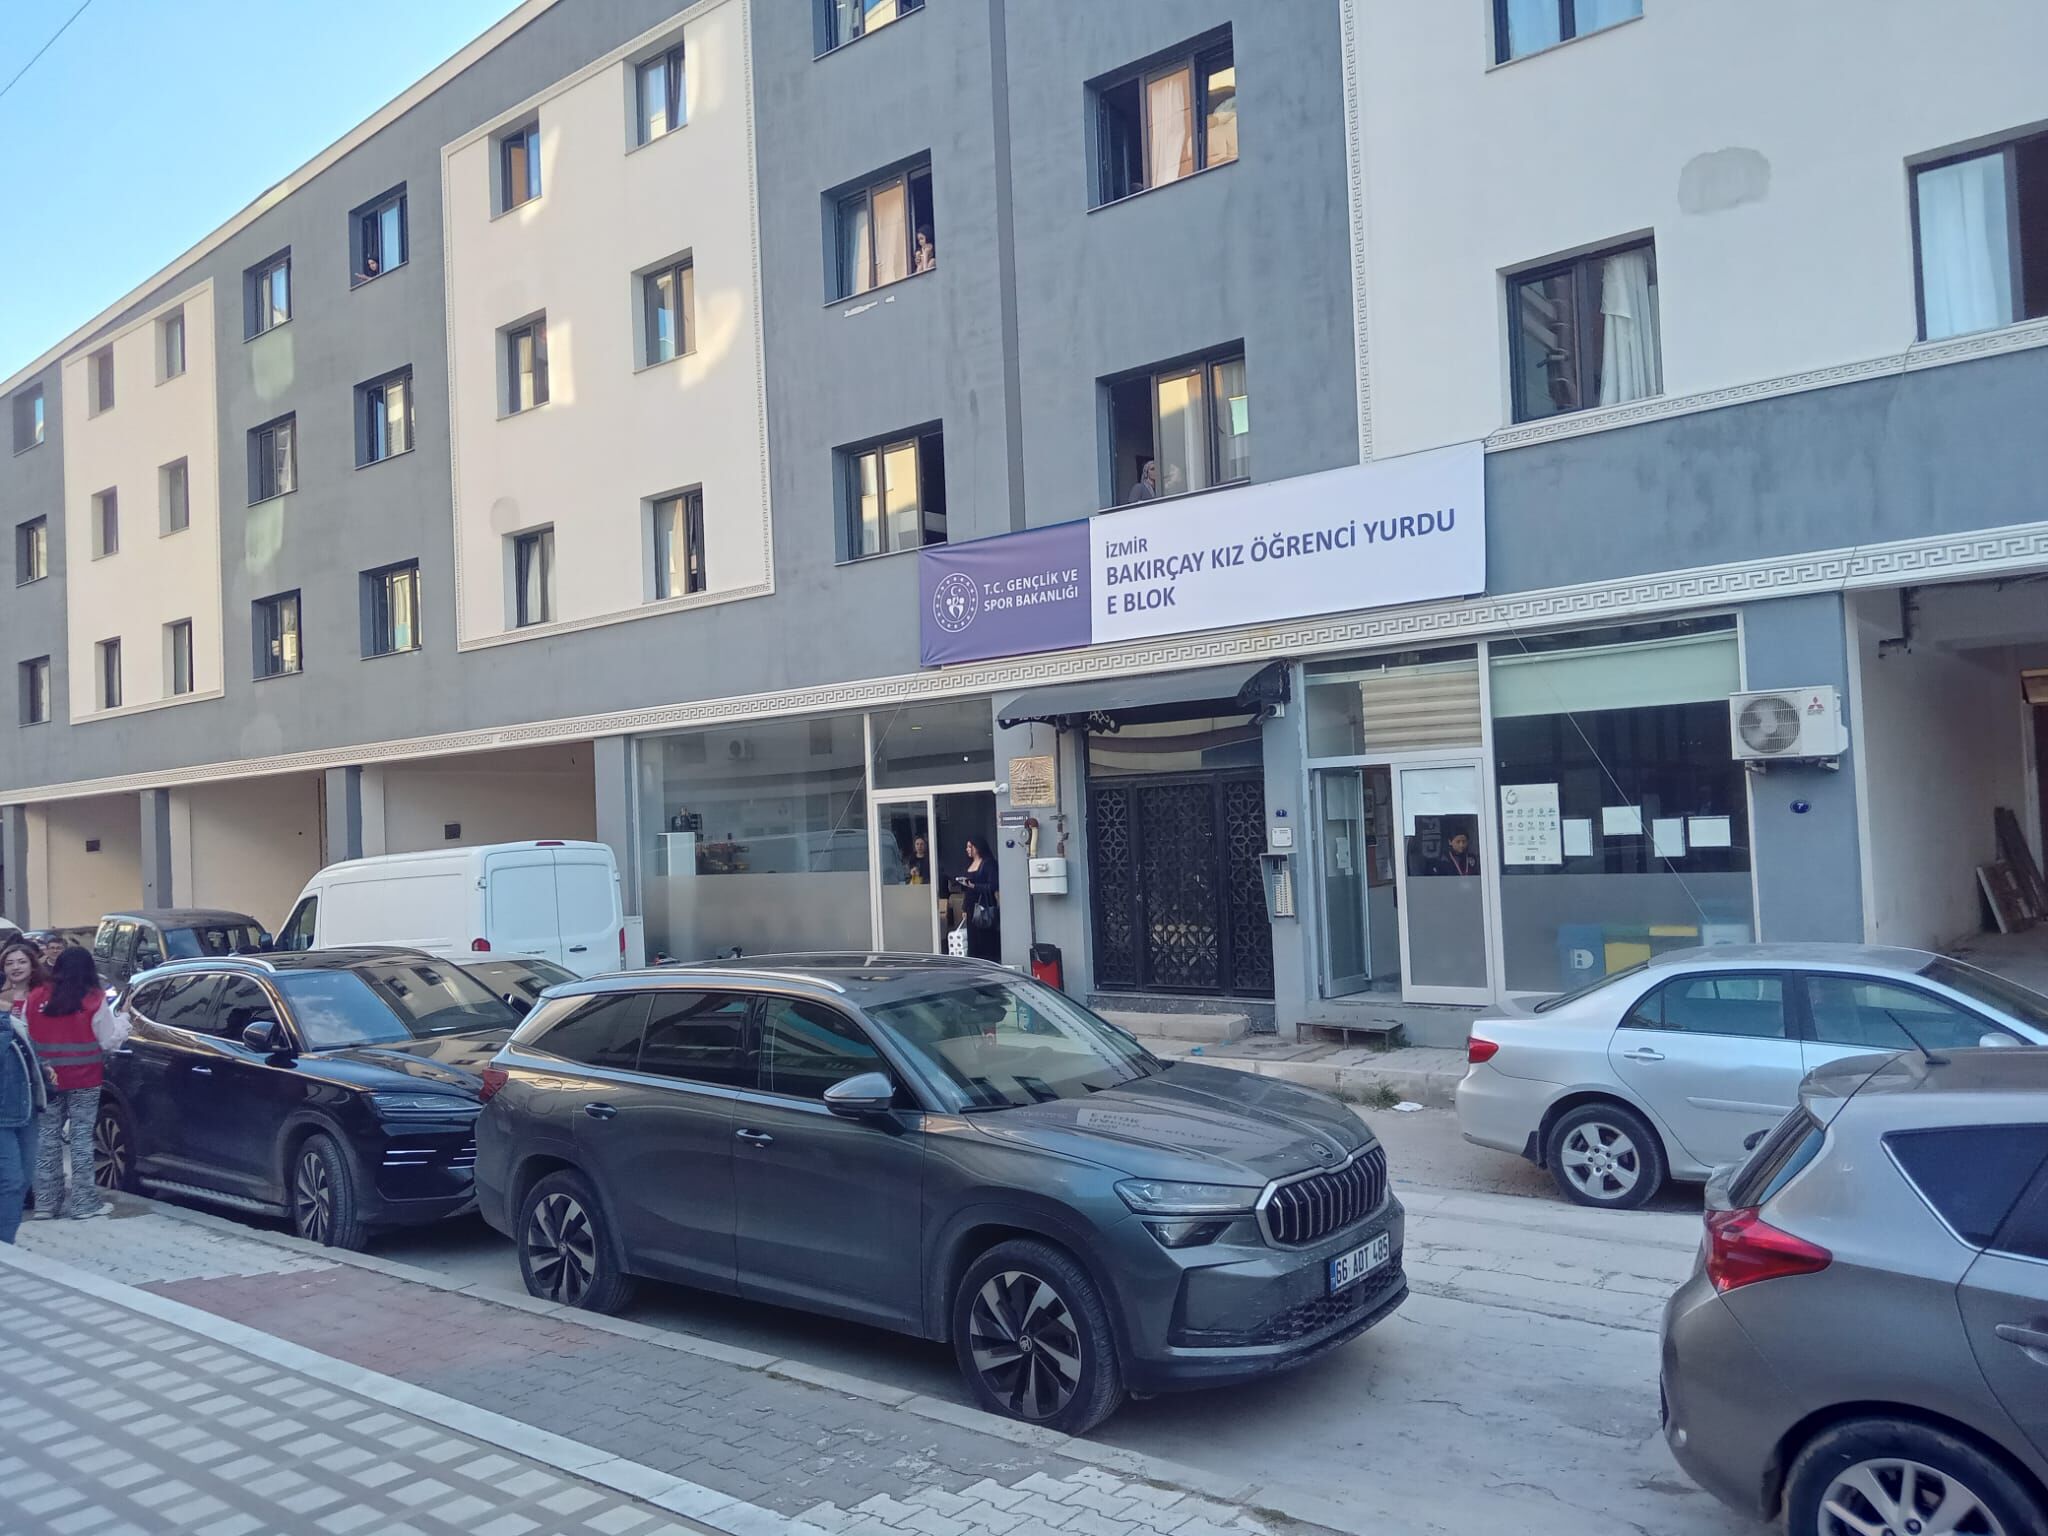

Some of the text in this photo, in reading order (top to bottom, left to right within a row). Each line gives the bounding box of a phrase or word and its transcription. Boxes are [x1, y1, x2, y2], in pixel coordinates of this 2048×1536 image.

[1105, 536, 1148, 559] İZMİR
[1106, 508, 1455, 586] BAKIRÇAY KIZ ÖĞRENCİ YURDU
[983, 569, 1078, 596] T.C. GENÇLİK VE
[984, 585, 1078, 612] SPOR BAKANLIĞI
[1107, 586, 1176, 615] E BLOK
[1336, 1236, 1387, 1284] 66 ADT 485
